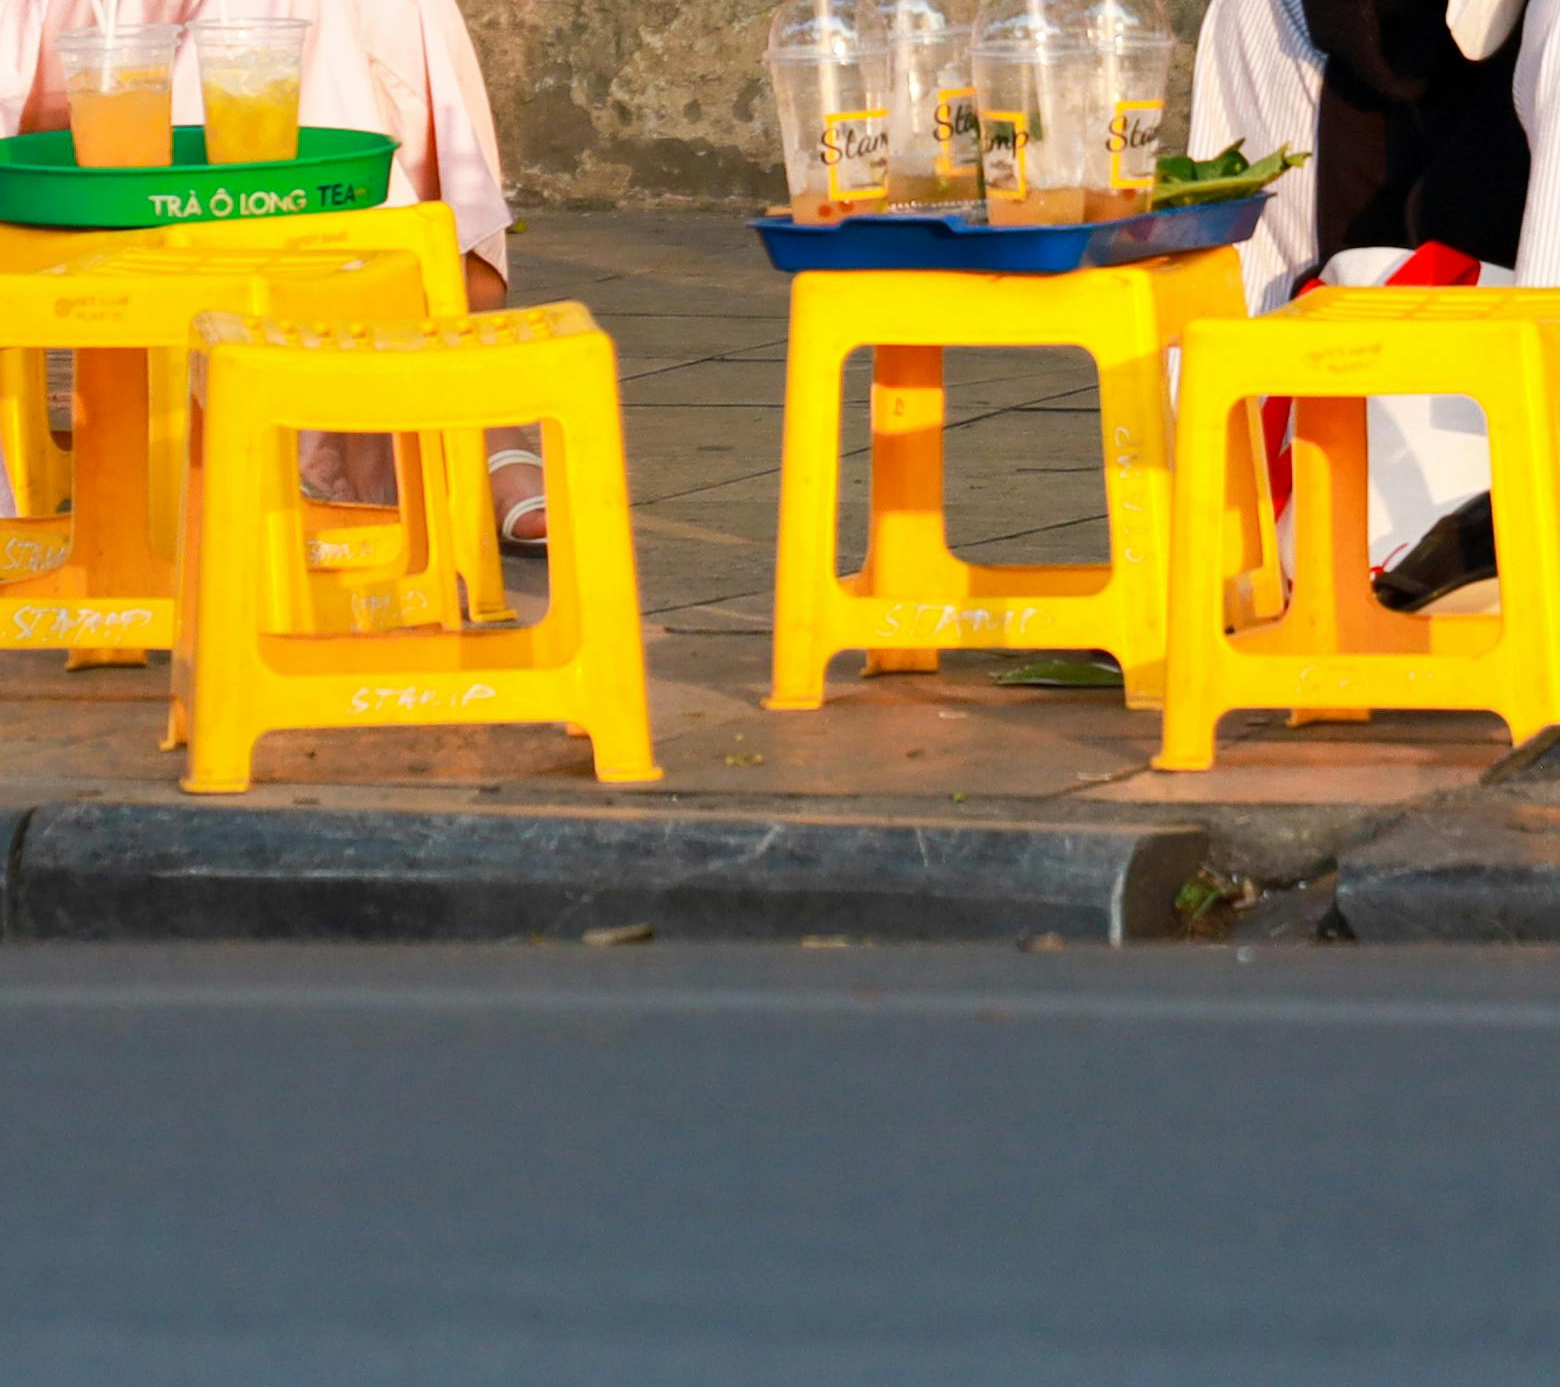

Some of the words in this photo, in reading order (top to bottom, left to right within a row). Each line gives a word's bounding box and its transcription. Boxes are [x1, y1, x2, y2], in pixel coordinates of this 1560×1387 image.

[148, 190, 202, 217] TRÀ
[209, 188, 234, 217] Ô
[240, 188, 307, 215] LONG
